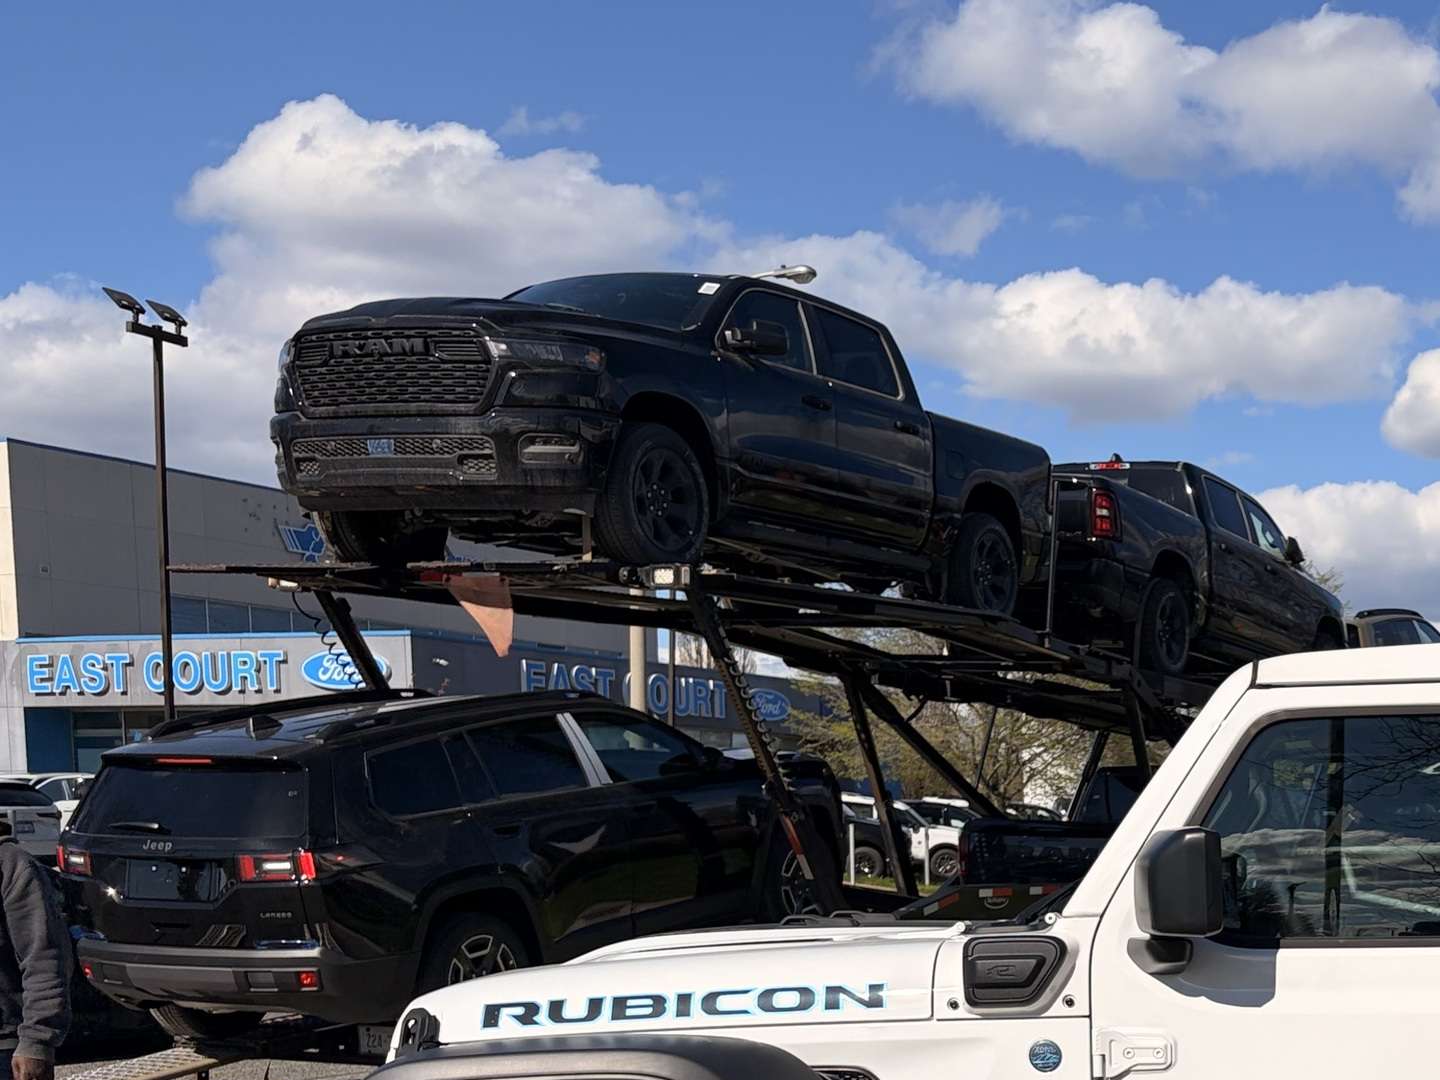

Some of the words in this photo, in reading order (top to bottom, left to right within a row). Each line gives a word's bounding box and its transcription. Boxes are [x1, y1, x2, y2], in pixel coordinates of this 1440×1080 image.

[333, 338, 425, 356] RAM
[27, 654, 131, 693] EAST
[144, 651, 284, 693] COURT
[521, 659, 616, 700] EAST
[751, 692, 785, 715] Ford
[143, 839, 172, 853] Jeep
[480, 983, 888, 1030] RUBICON
